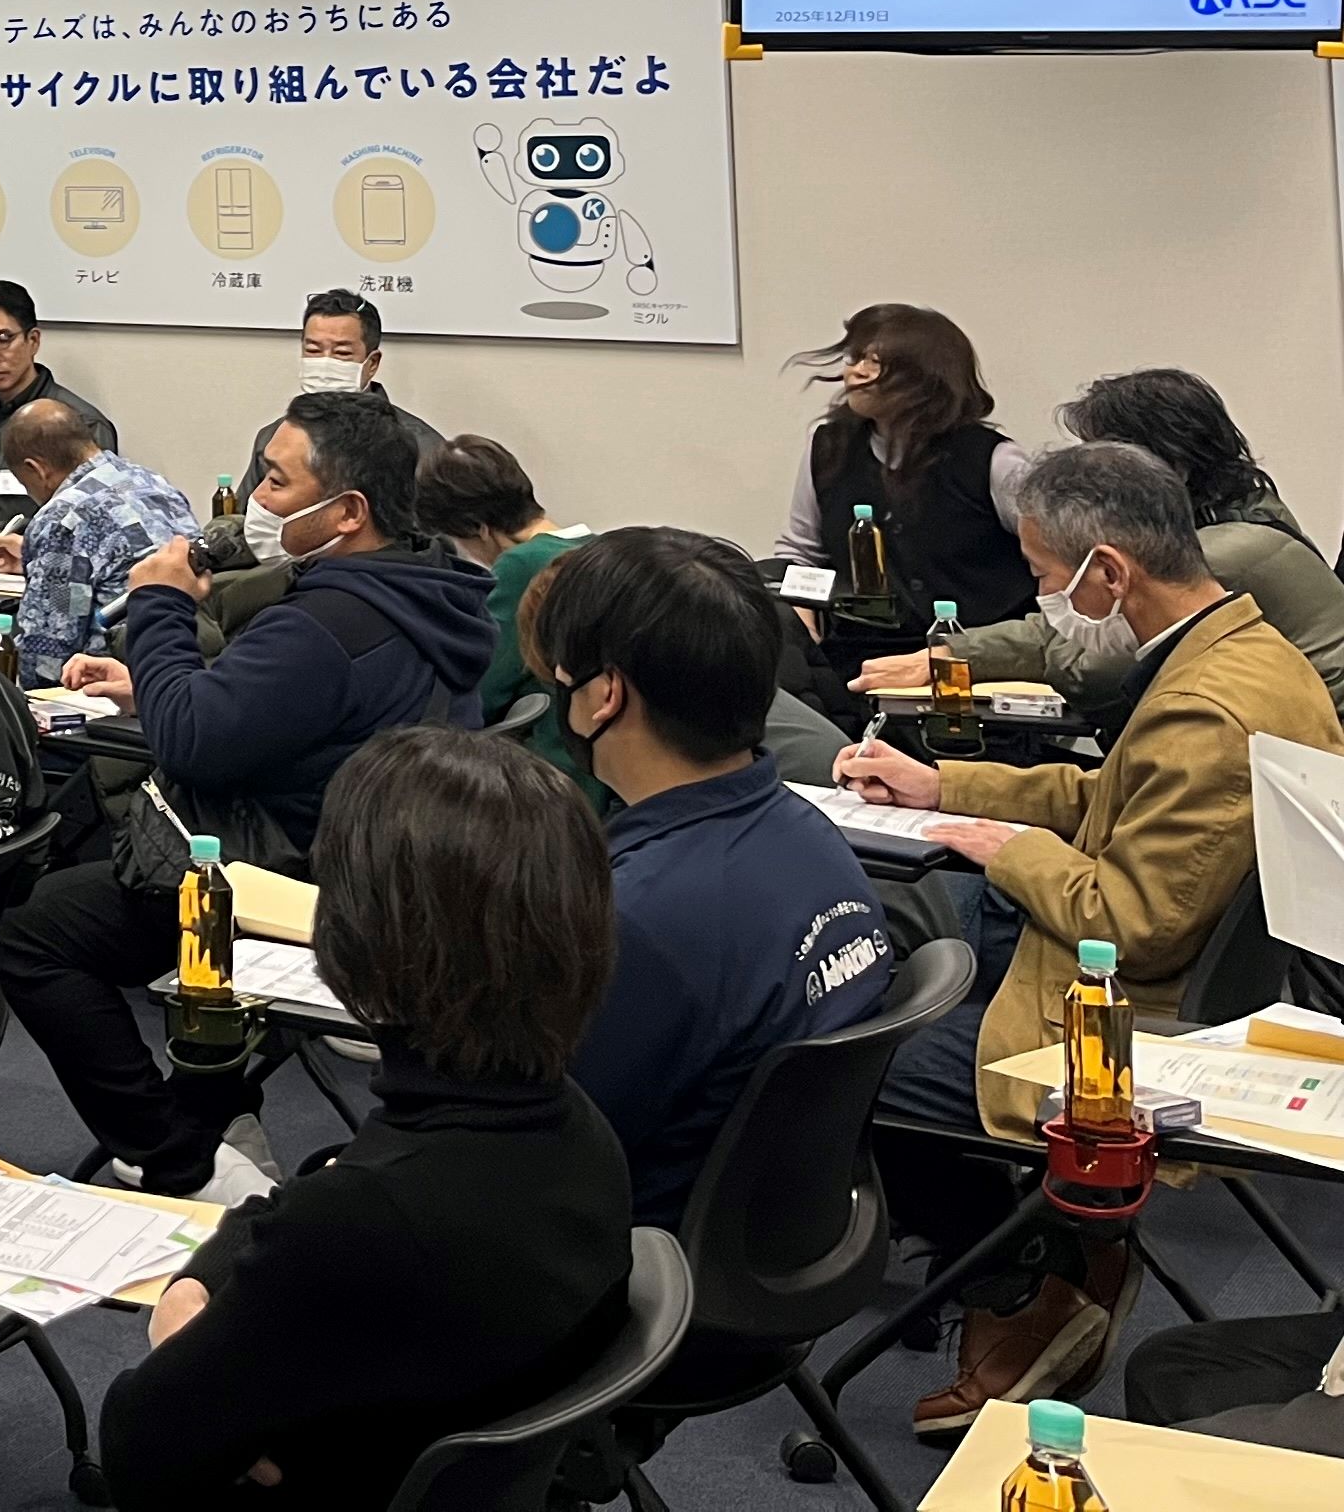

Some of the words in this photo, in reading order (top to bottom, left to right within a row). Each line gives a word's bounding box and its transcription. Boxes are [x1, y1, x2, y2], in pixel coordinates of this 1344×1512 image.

[776, 10, 889, 23] 2025年12月19日
[201, 145, 265, 162] REFRIGERATOR
[341, 144, 380, 166] WASHING
[382, 144, 424, 167] MACHINE
[75, 270, 121, 285] テレビ
[211, 271, 263, 289] 冷蔵庫
[359, 274, 414, 293] 洗濯機
[633, 312, 669, 325] ミクル
